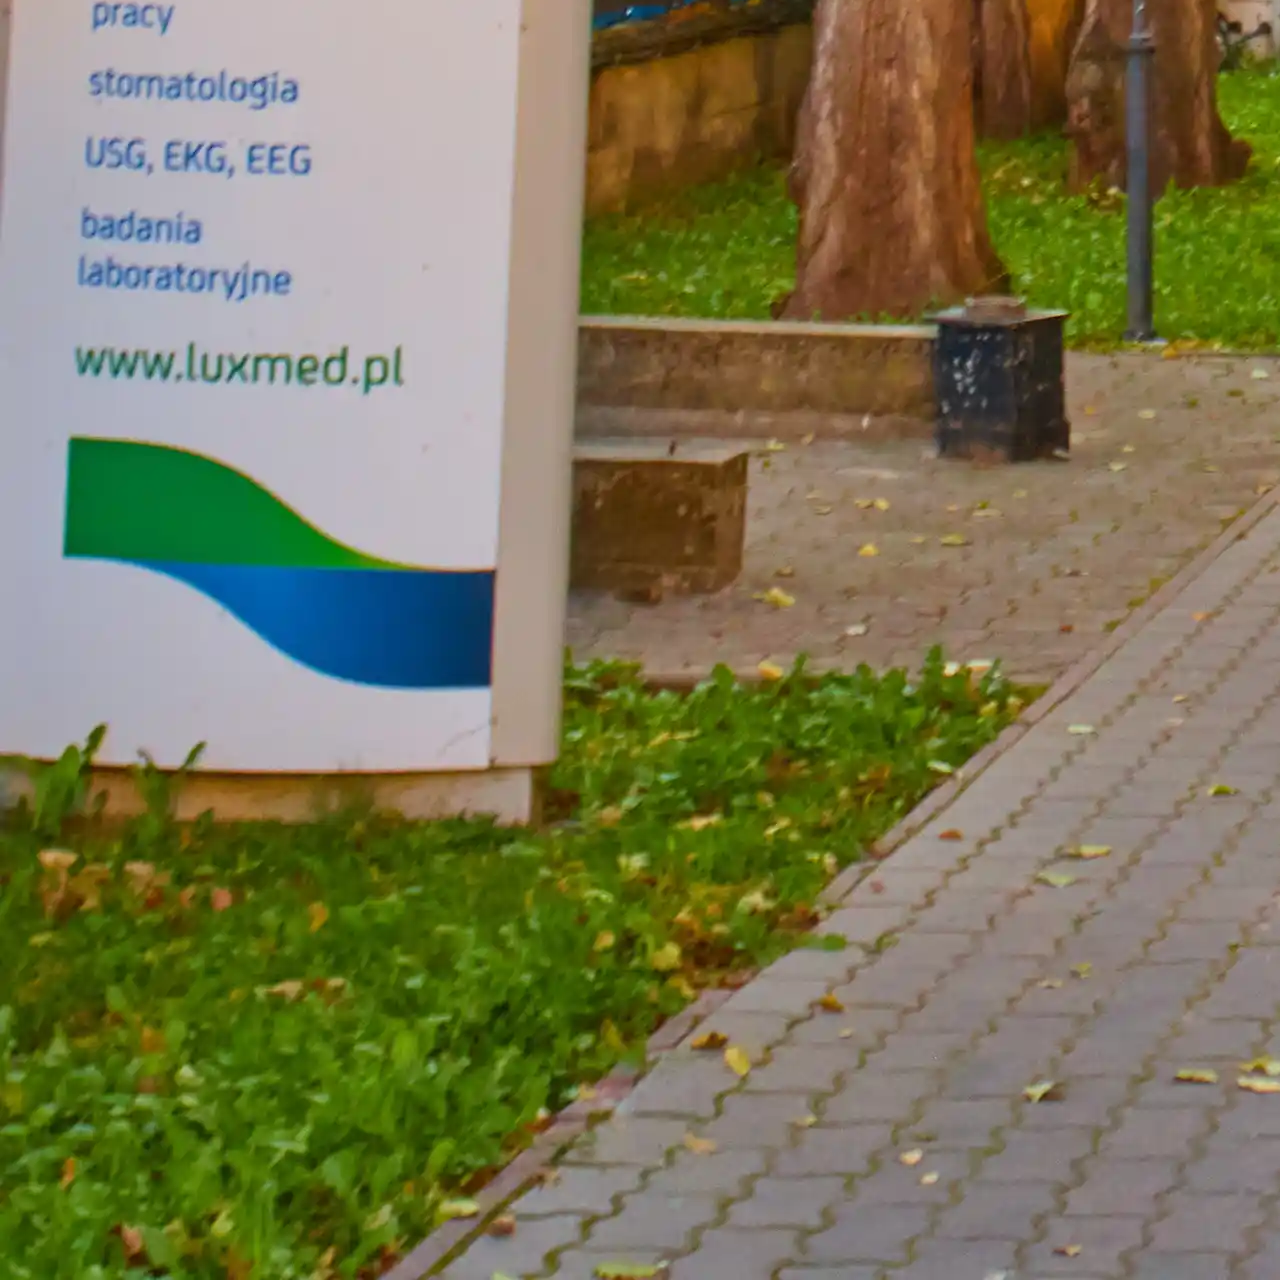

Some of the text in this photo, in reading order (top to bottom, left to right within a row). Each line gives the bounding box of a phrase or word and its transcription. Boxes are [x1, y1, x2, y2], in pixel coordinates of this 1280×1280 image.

[91, 0, 175, 36] pracy
[88, 67, 299, 111] stomatologia
[84, 136, 312, 179] USG, EKG, EEG
[80, 206, 202, 245] badania
[77, 254, 292, 302] laboratoryjne
[73, 340, 403, 395] www.luxmed.pl
